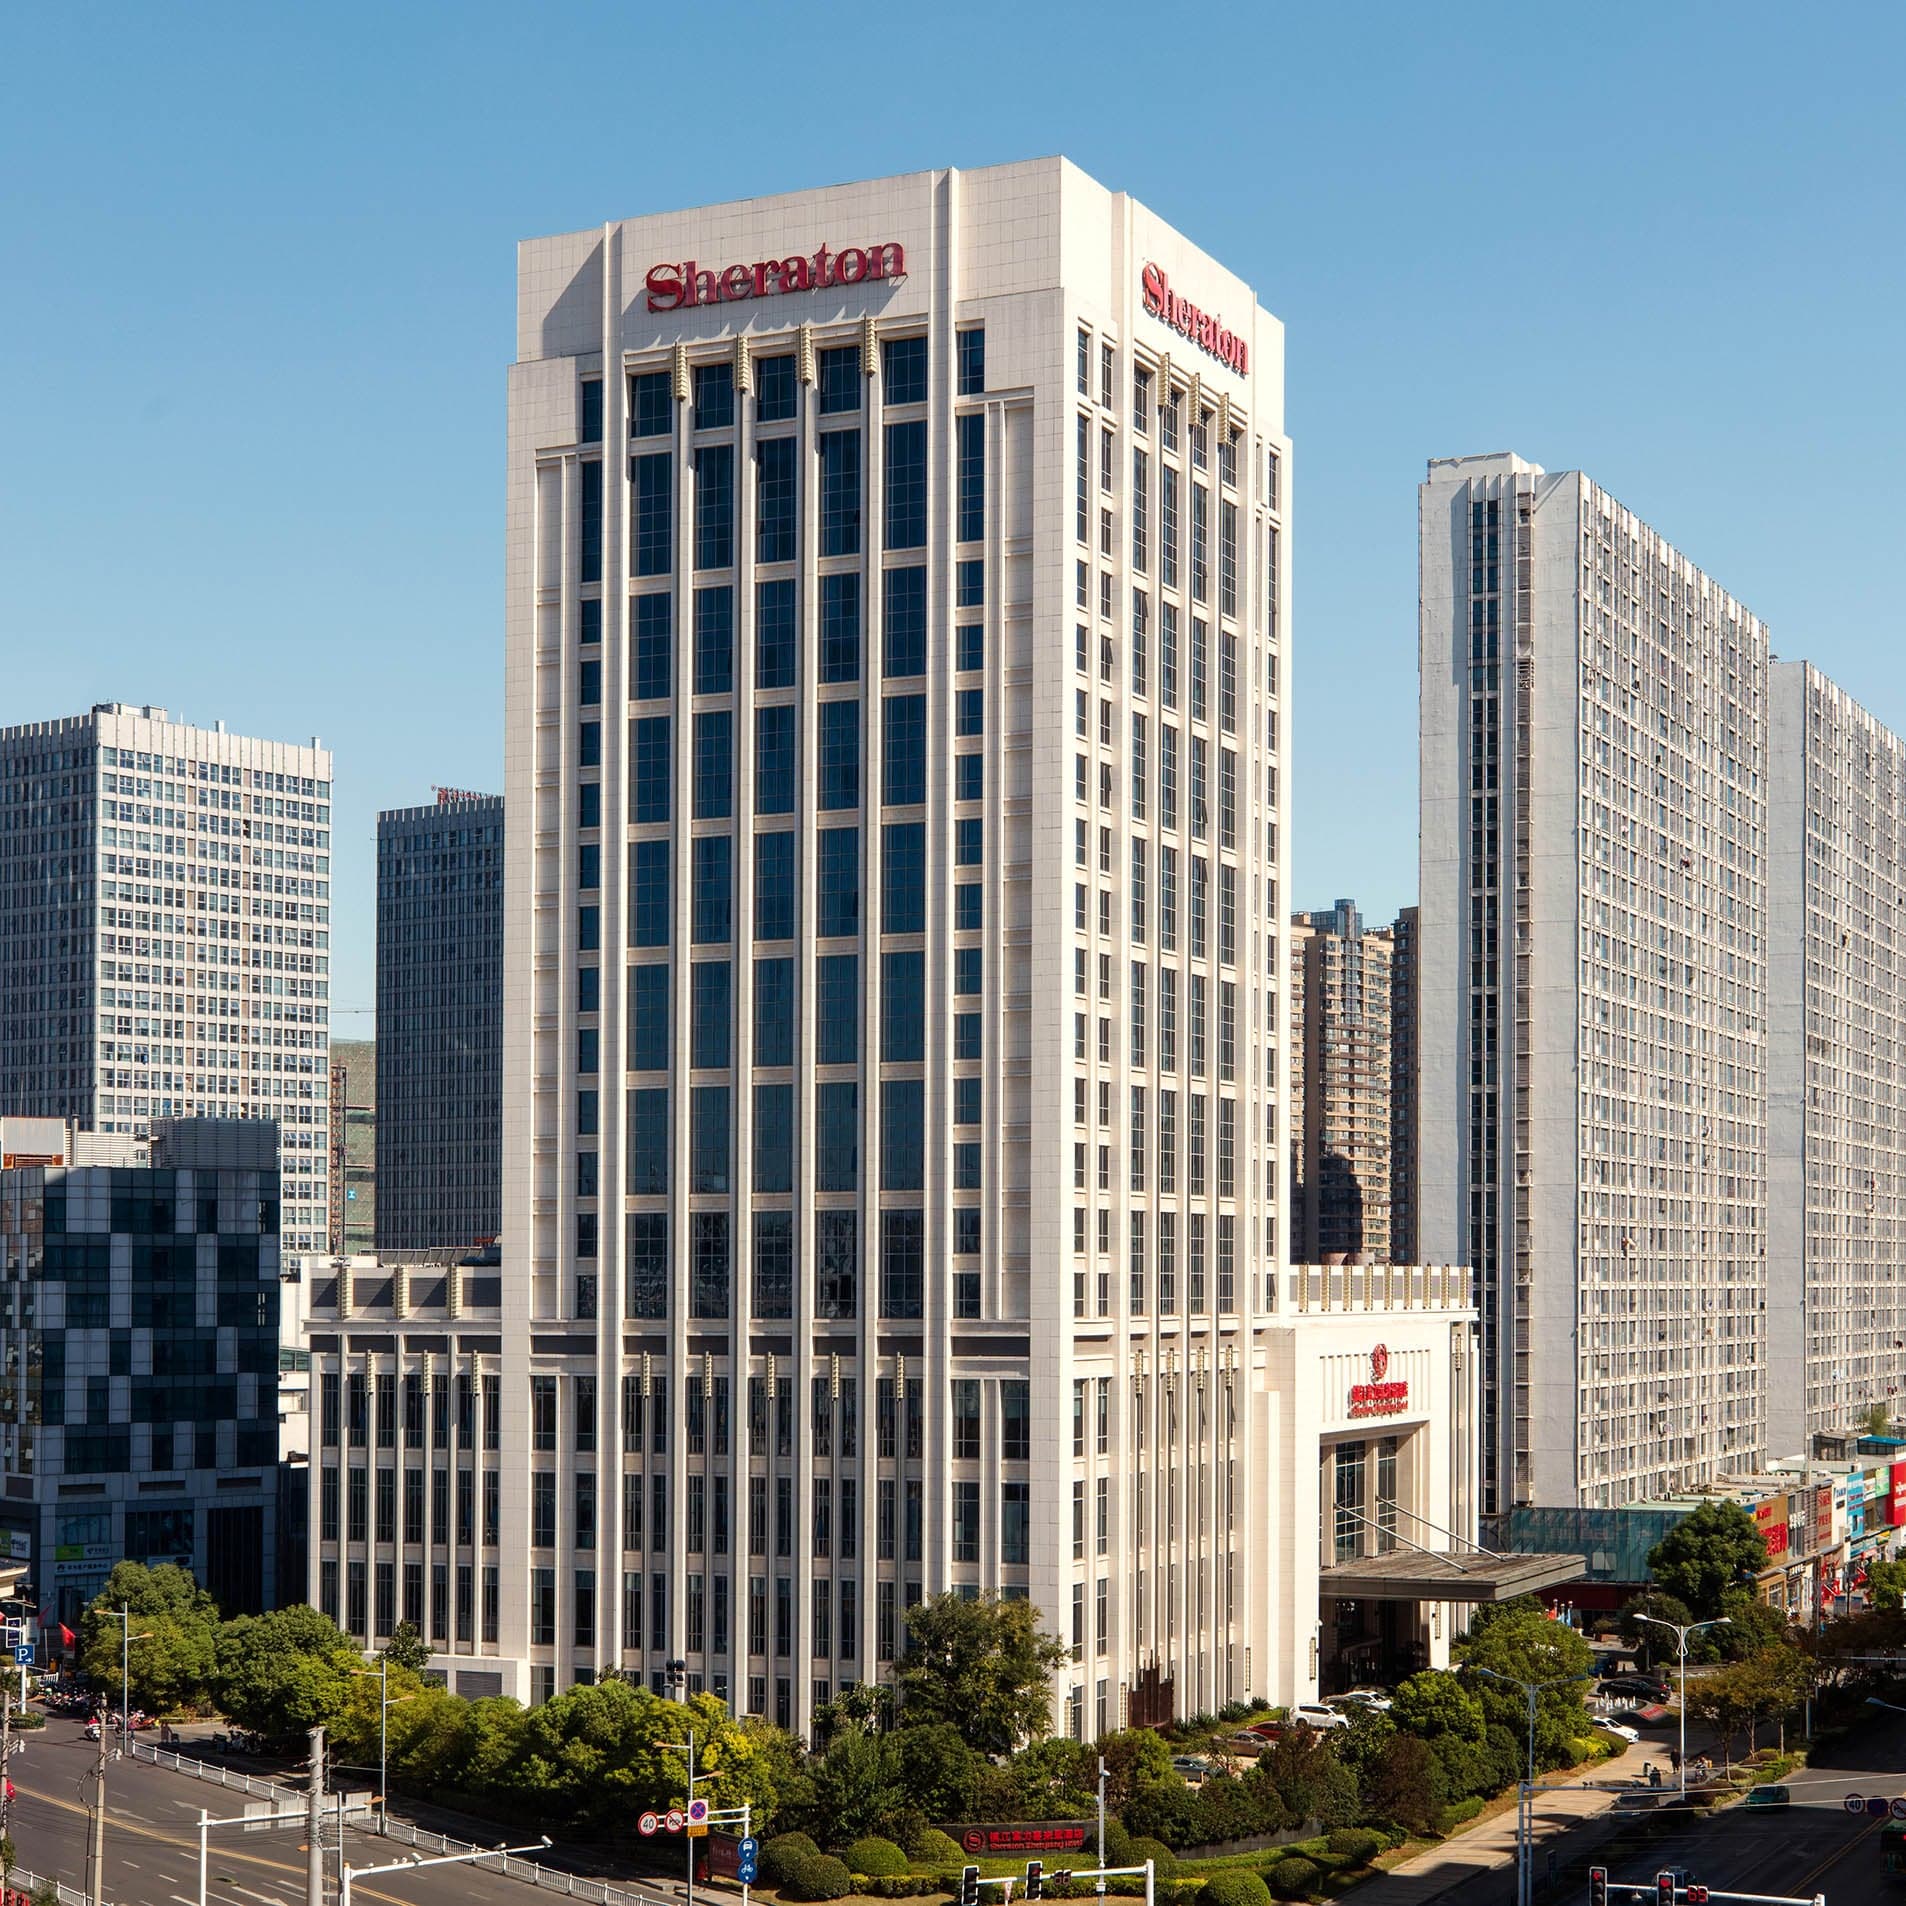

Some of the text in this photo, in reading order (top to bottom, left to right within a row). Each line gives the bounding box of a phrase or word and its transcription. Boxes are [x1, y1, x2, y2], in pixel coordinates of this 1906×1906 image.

[645, 242, 906, 312] Sheraton
[1142, 262, 1248, 375] Sheraton
[17, 1648, 28, 1662] P
[643, 1818, 654, 1830] 40
